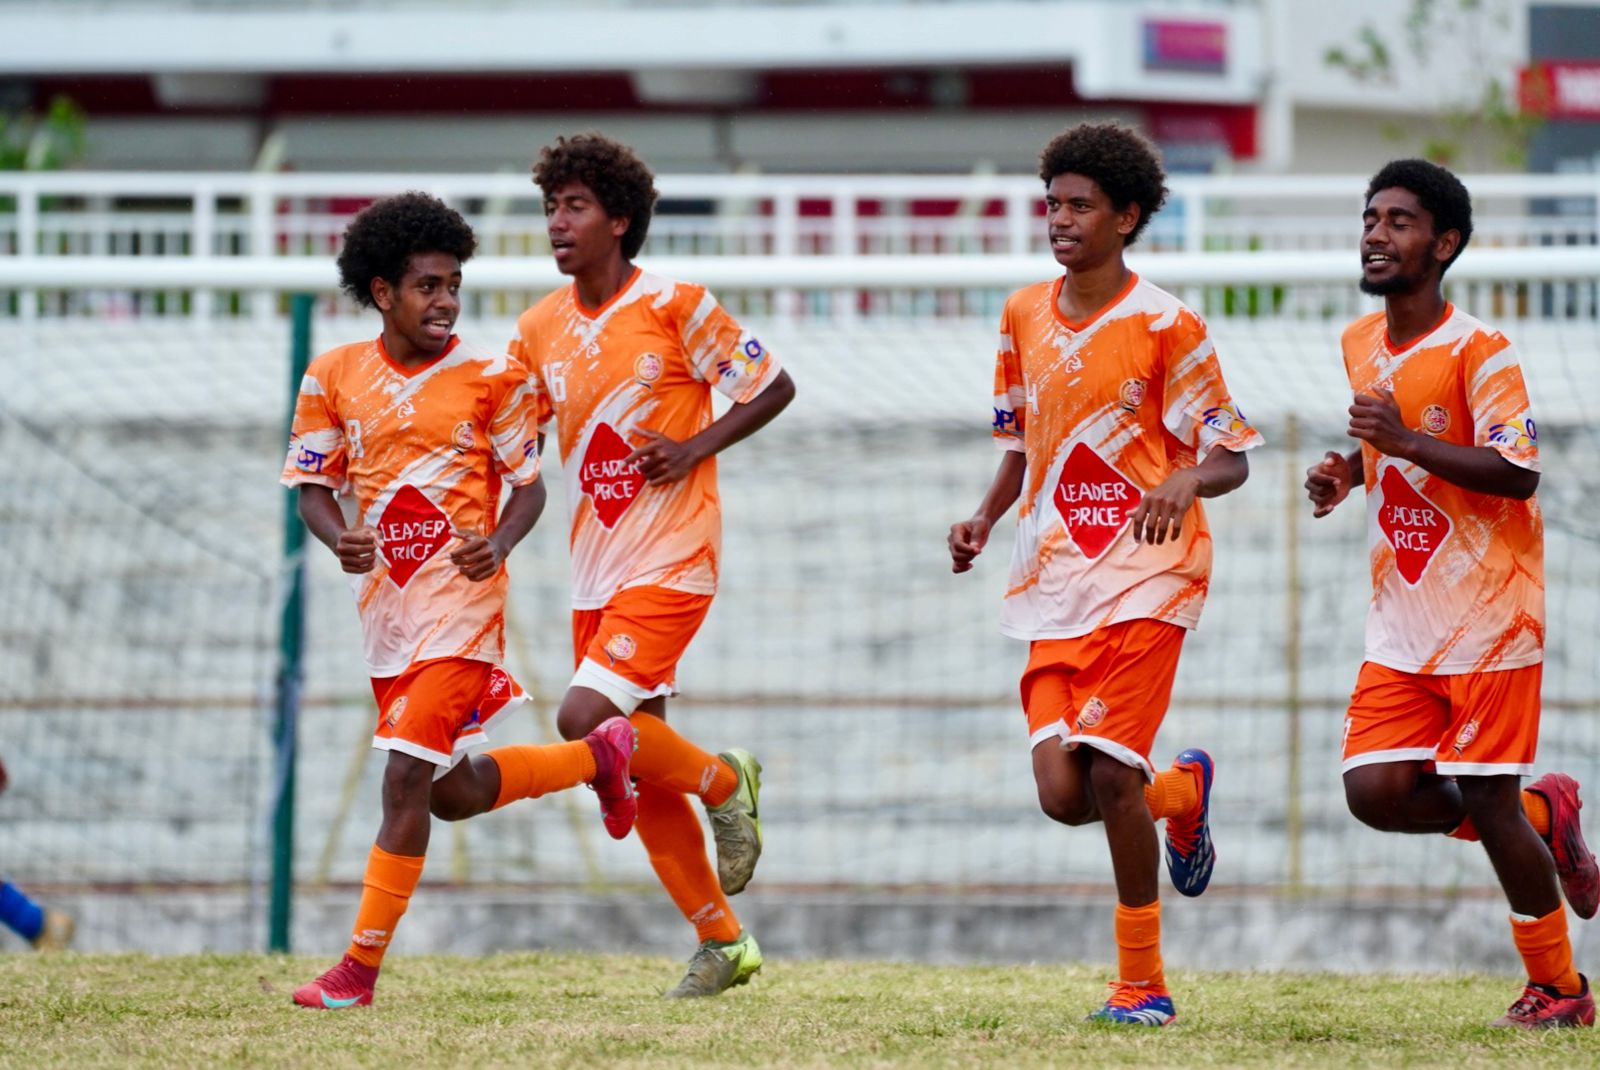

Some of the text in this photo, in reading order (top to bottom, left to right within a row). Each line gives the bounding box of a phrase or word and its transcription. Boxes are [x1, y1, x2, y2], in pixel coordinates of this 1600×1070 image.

[1060, 481, 1129, 503] LEADER
[1069, 506, 1121, 528] PRICE
[1386, 505, 1438, 527] ADER
[379, 519, 446, 542] LEADER
[1392, 530, 1431, 552] RICE
